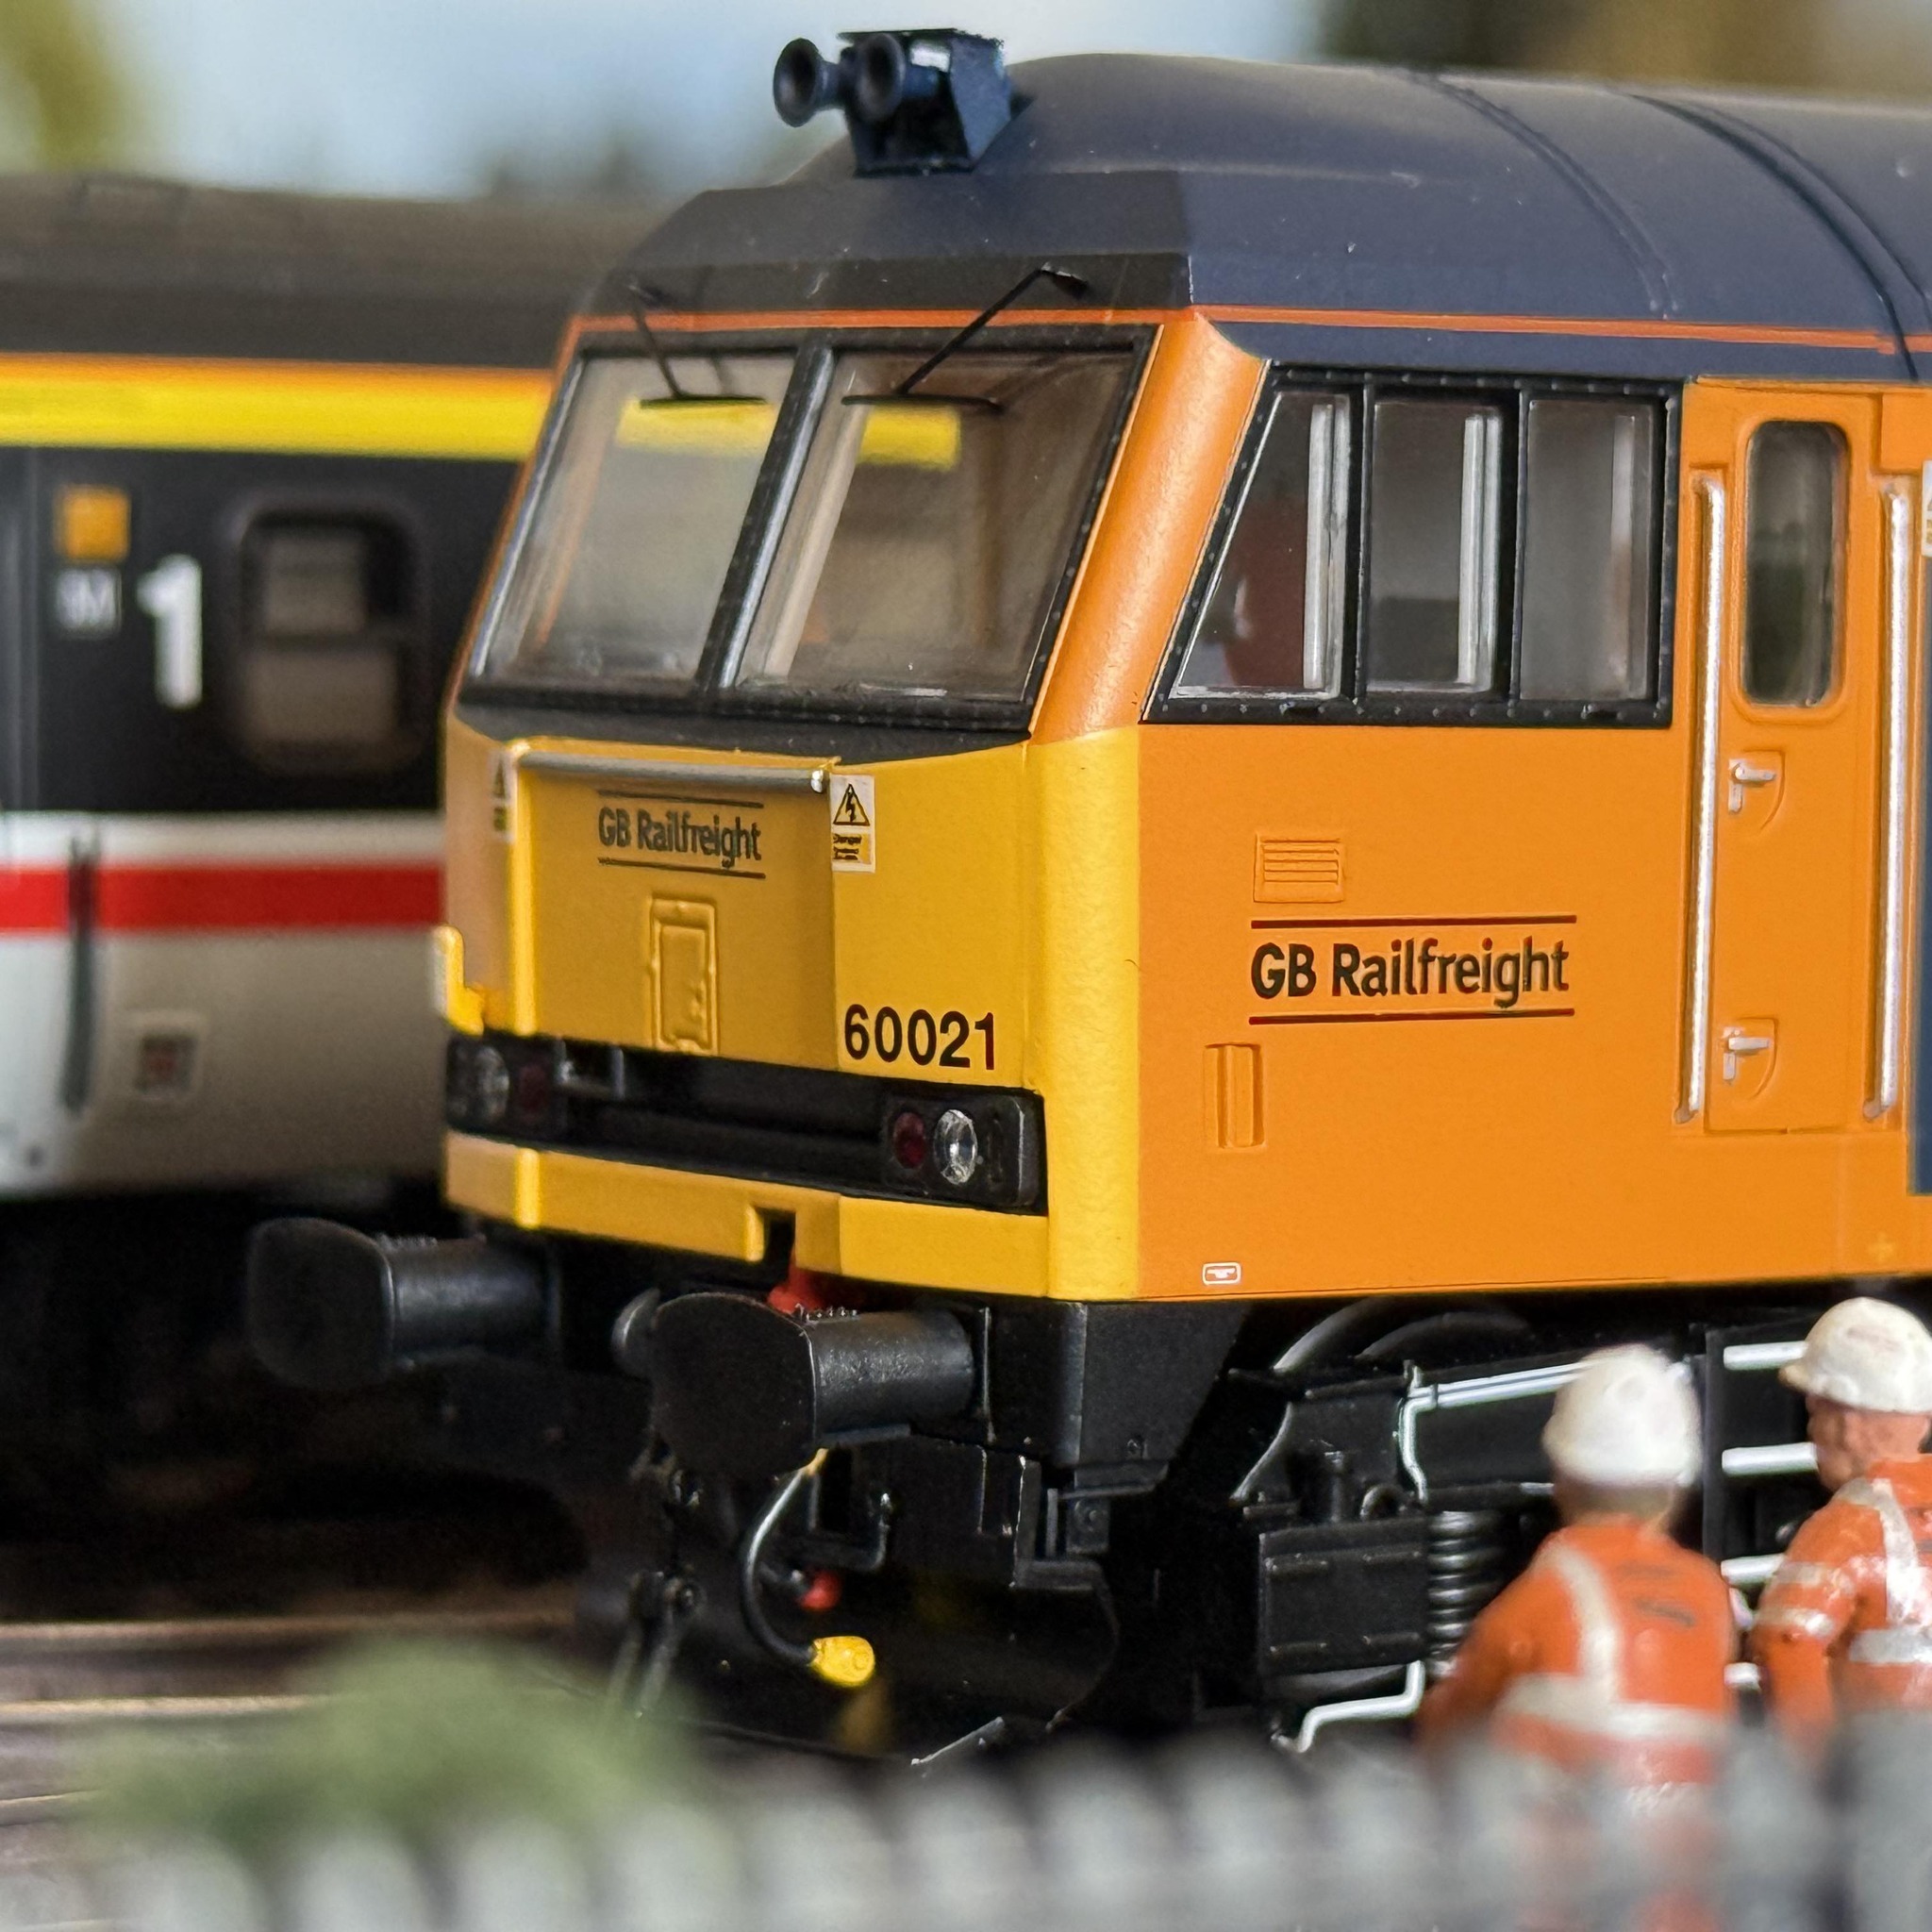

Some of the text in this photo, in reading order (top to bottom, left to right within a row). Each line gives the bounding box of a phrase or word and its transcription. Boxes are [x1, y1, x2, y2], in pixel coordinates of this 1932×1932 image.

[139, 554, 203, 708] 1
[597, 806, 762, 869] GB Railfreight
[1250, 936, 1570, 1008] GB Railfreight
[844, 1003, 995, 1071] 60021
